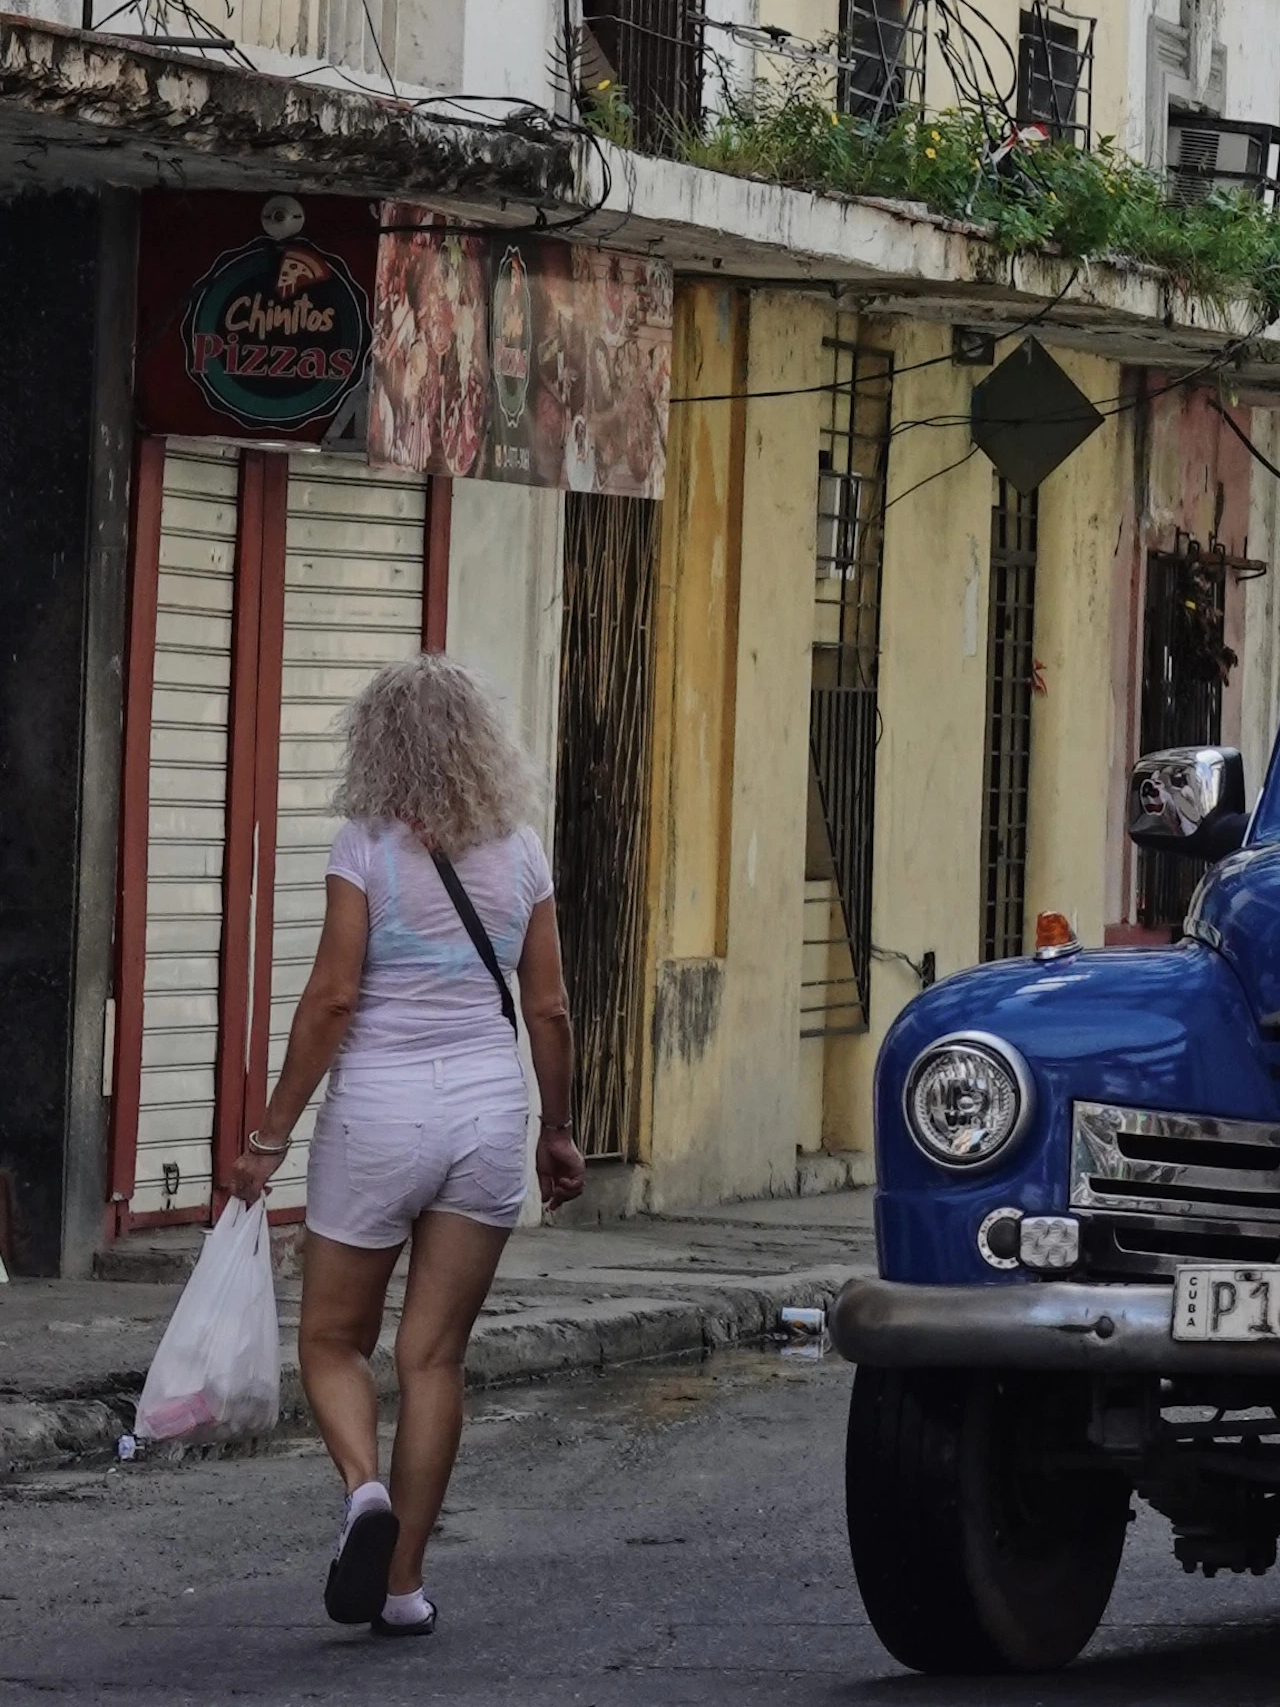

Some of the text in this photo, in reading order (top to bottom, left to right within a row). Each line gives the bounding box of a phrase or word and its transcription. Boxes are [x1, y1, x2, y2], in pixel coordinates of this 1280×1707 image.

[225, 292, 335, 340] Chinitos
[191, 332, 355, 380] Pizzas
[1187, 1276, 1198, 1327] CUBA
